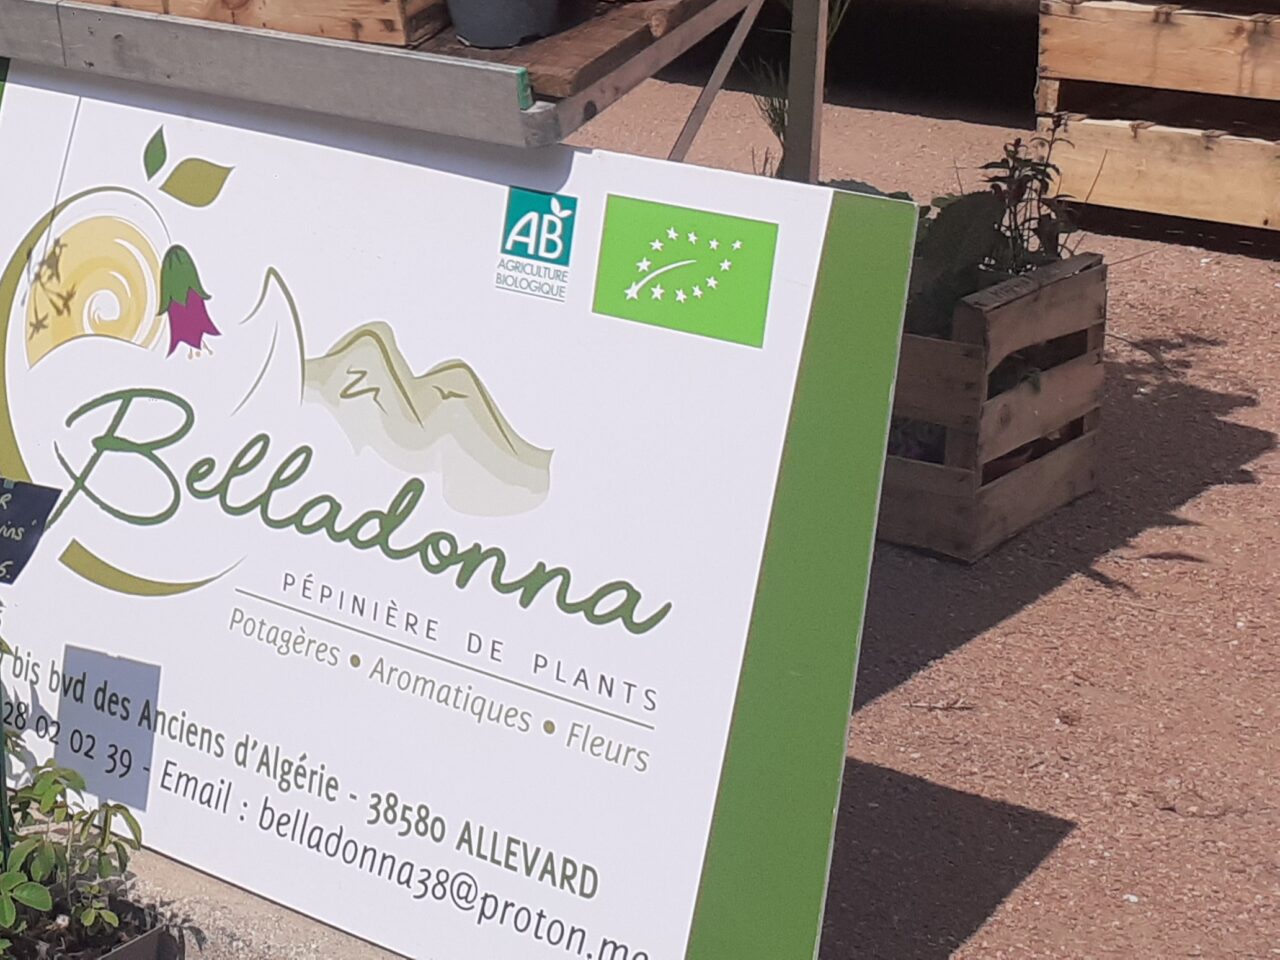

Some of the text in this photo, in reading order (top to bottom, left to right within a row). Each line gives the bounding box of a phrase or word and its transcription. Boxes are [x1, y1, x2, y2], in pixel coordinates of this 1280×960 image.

[495, 272, 566, 299] BIOLOGIQUE
[496, 258, 569, 284] AGRICULTURE
[505, 210, 563, 260] AB
[43, 388, 673, 635] Belladonna
[229, 607, 650, 773] Potagères Aromatiques Fleurs
[282, 572, 657, 711] PÉPINIÈRE DE PLANTS
[3, 700, 29, 730] 28
[35, 715, 62, 746] 02
[70, 728, 97, 760] 02
[104, 743, 133, 779] 39
[159, 759, 233, 815] Email
[12, 646, 41, 687] bis
[48, 660, 87, 705] bvd
[94, 680, 131, 722] des
[137, 698, 226, 759] Anciens
[366, 792, 447, 844] 38580
[455, 820, 600, 900] ALLEVARD
